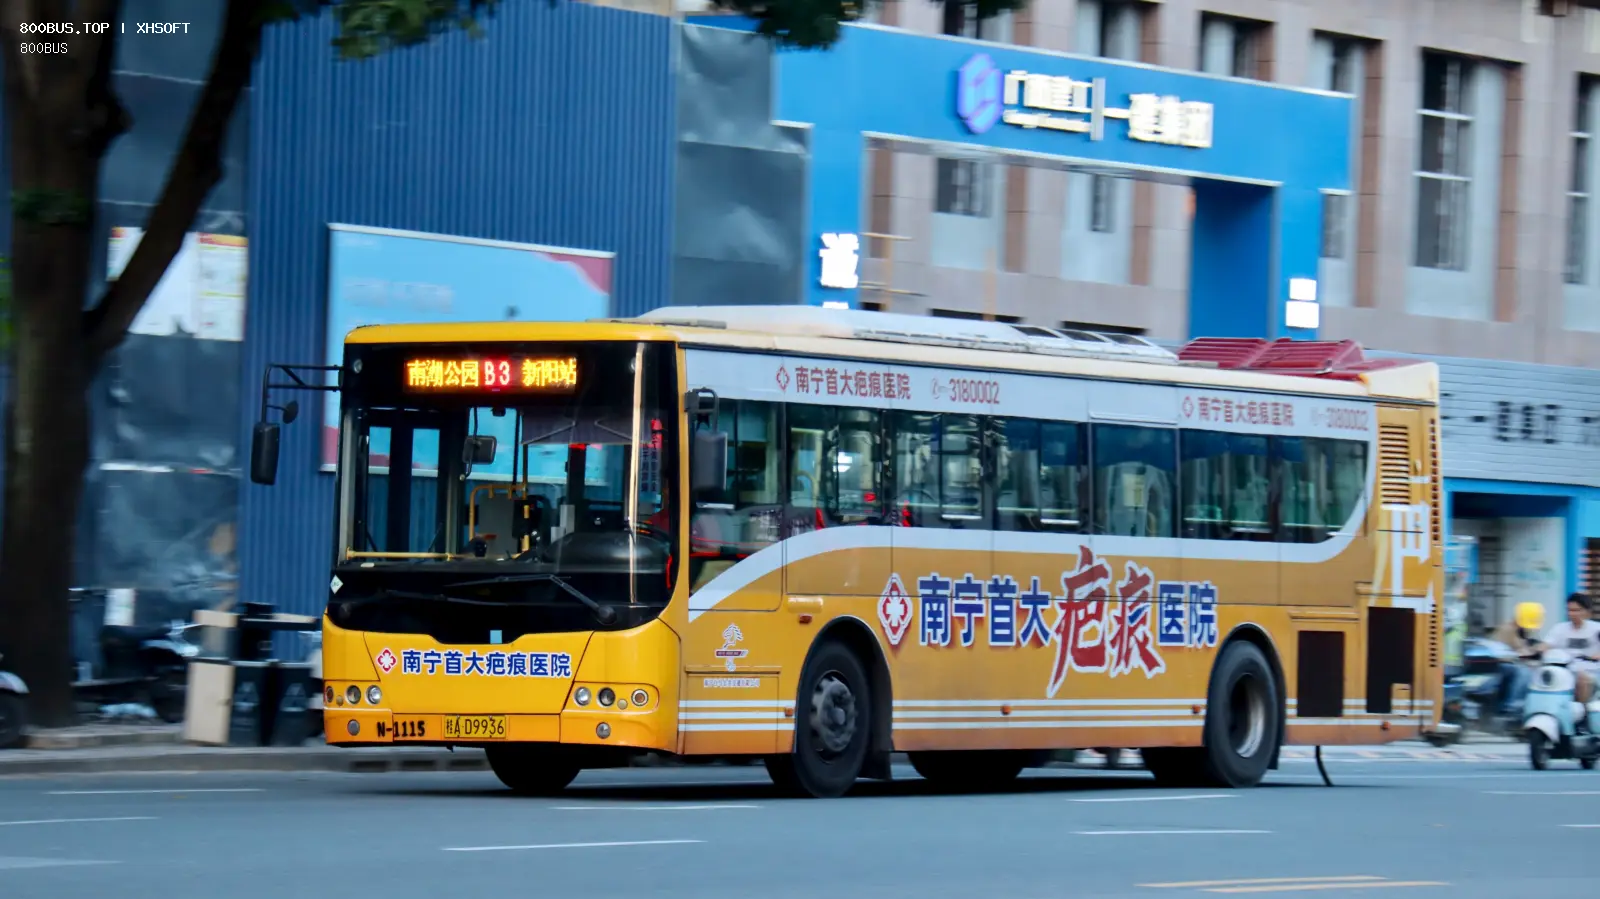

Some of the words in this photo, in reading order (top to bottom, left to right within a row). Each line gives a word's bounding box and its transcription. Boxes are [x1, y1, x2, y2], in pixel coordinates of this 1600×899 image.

[407, 359, 479, 387] 南湖公园
[522, 357, 577, 387] 新阳站
[795, 366, 911, 400] 南宁首大疤痕医院
[949, 378, 1000, 404] 3180002
[402, 650, 572, 678] 南宁首大疤痕医院
[377, 720, 426, 737] N-1115
